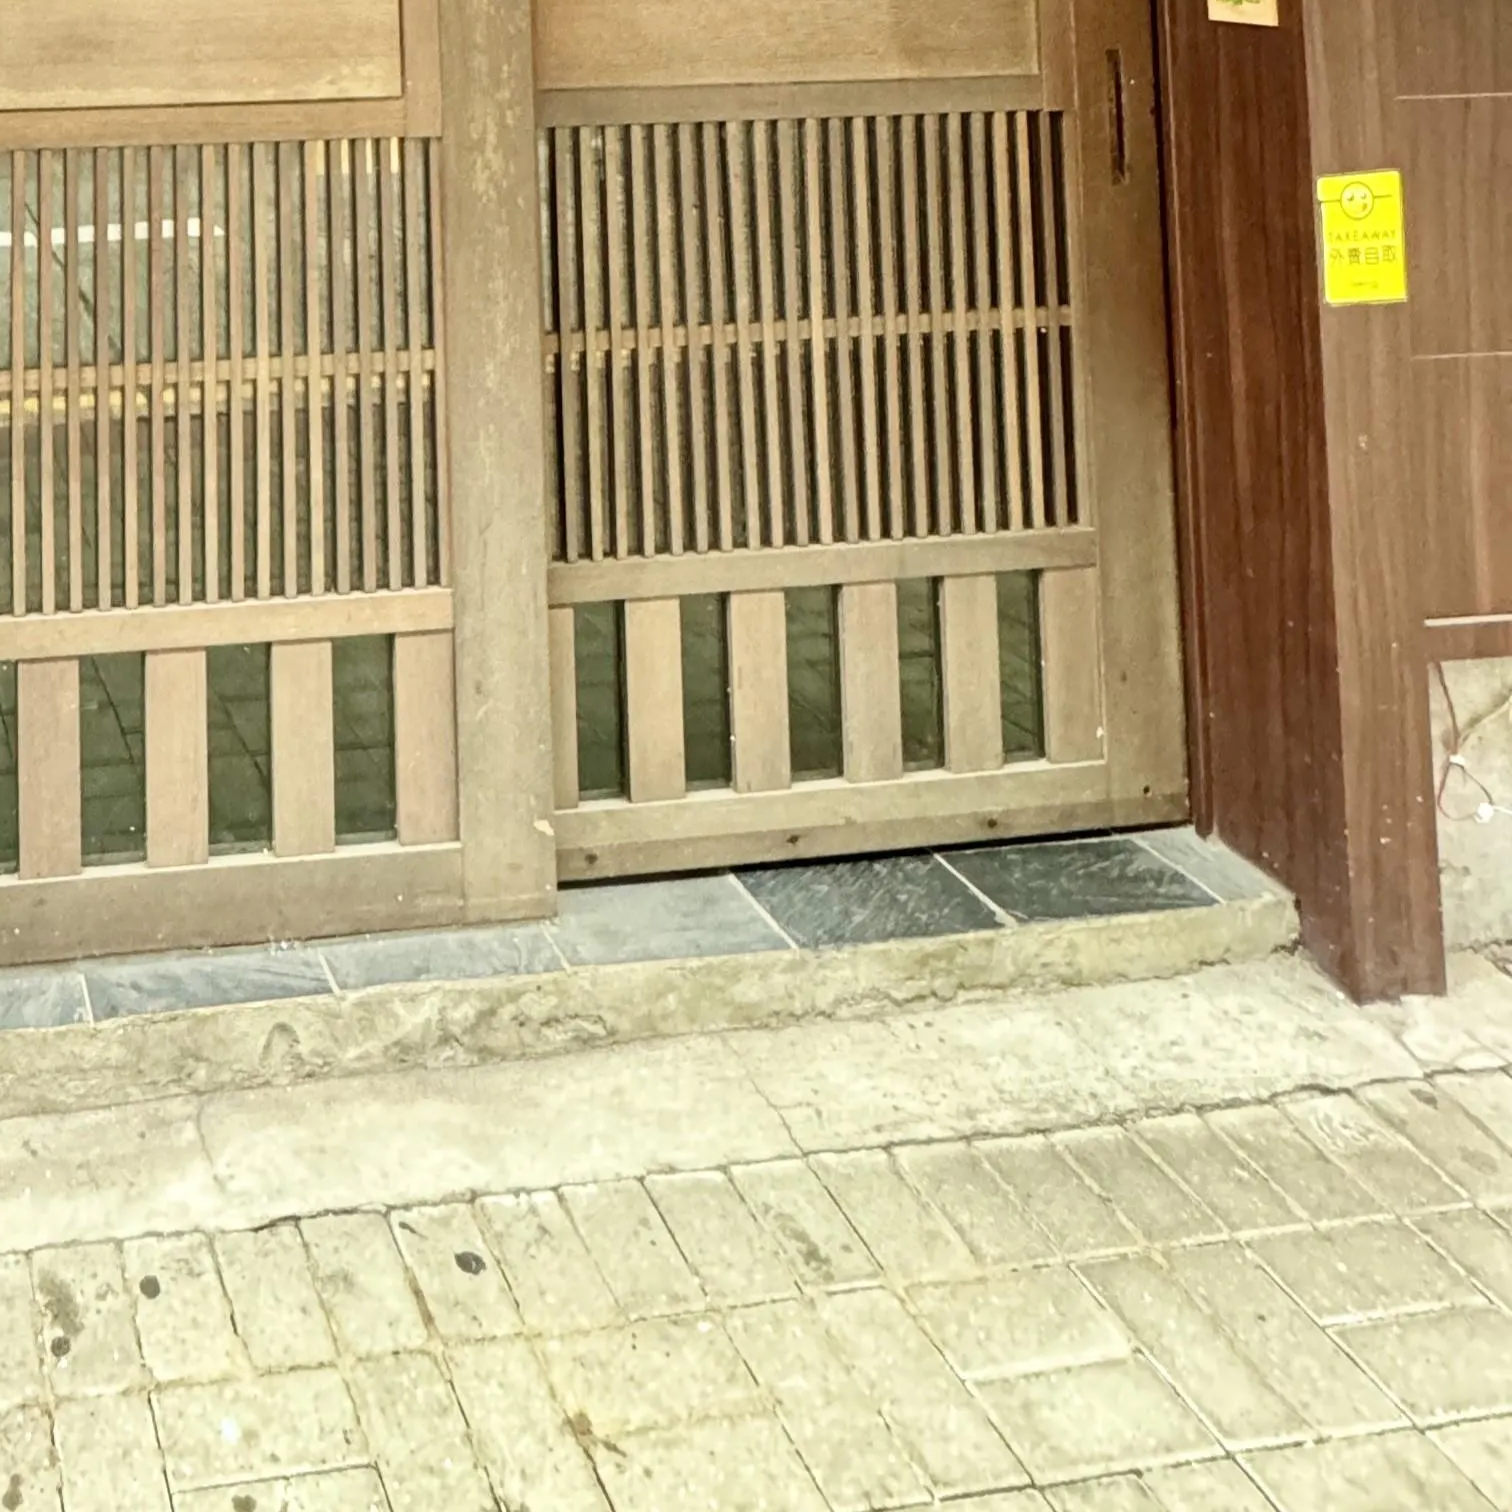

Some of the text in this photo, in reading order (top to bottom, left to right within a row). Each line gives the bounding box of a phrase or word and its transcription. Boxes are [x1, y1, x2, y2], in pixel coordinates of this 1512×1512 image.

[1328, 229, 1397, 243] TAKEAWAY
[1329, 245, 1397, 268] 外賣自取
